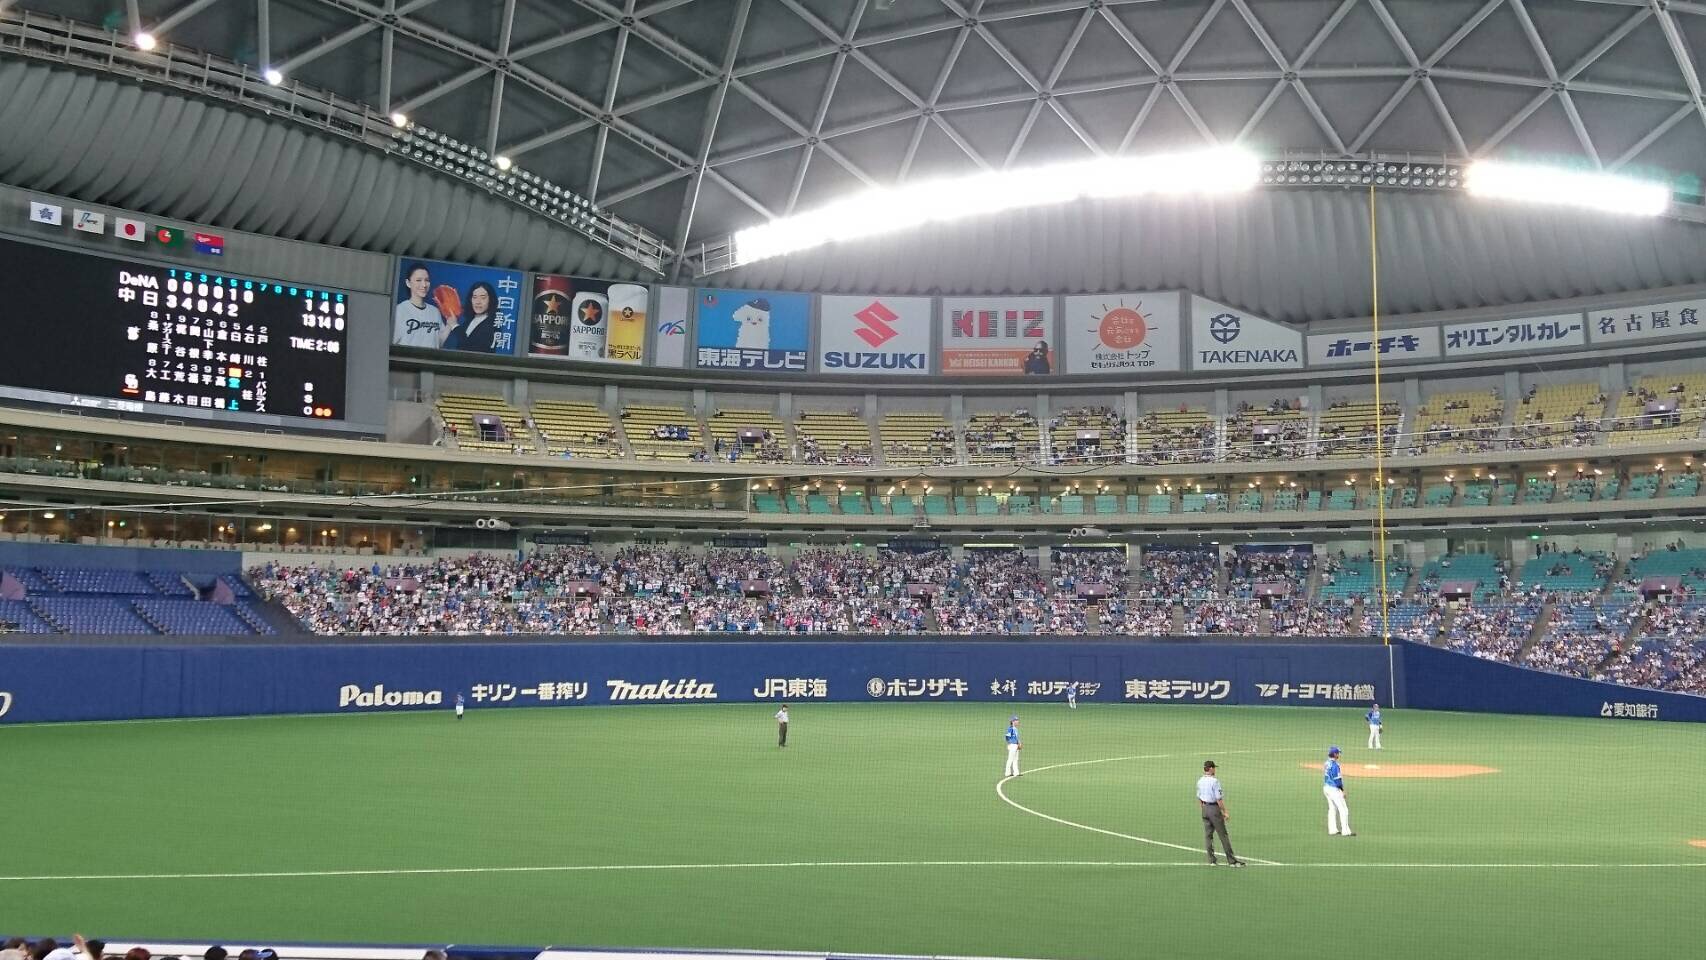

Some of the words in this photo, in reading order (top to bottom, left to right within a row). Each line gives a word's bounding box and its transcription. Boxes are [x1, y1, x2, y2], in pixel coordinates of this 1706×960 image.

[119, 271, 159, 290] DeNA
[167, 279, 178, 292] 0
[182, 281, 193, 294] 0
[197, 284, 208, 297] 0
[213, 286, 223, 299] 0
[228, 288, 237, 301] 1
[243, 290, 253, 303] 0
[305, 299, 313, 312] 1
[319, 301, 329, 314] 4
[335, 303, 344, 316] 0
[170, 269, 176, 278] 1
[184, 272, 192, 280] 2
[199, 274, 208, 283] 3
[214, 277, 222, 285] 4
[230, 279, 238, 287] 5
[244, 281, 252, 290] 6
[260, 284, 268, 292] 7
[274, 286, 282, 294] 8
[289, 288, 297, 296] 9
[336, 294, 343, 302] E
[118, 287, 159, 307] 中日
[166, 295, 177, 308] 3
[181, 297, 192, 310] 4
[197, 299, 208, 312] 0
[212, 302, 223, 315] 4
[227, 304, 238, 317] 2
[301, 313, 316, 328] 13
[317, 315, 331, 329] 14
[334, 317, 344, 331] 0
[490, 275, 518, 350] 中日新聞
[150, 311, 158, 319] 8
[165, 313, 170, 321] 1
[178, 315, 186, 323] 9
[206, 319, 213, 327] 3
[233, 323, 240, 331] 5
[951, 310, 1044, 338] KEIZ
[1598, 307, 1699, 335] 名古屋食
[290, 336, 315, 350] TIME
[1447, 321, 1581, 349] オリエンタルカレー
[608, 349, 641, 360] 黒ラベル
[1126, 349, 1151, 359] トップ
[1326, 334, 1419, 357] ホーチキ
[697, 347, 806, 369] 東海テレビ
[824, 351, 926, 369] SUZUKI
[1200, 349, 1298, 364] TAKENAKA
[149, 359, 157, 367] 8
[176, 362, 184, 370] 4
[190, 364, 197, 372] 3
[217, 367, 225, 375] 5
[304, 394, 313, 403] S
[339, 684, 442, 707] Paloma
[471, 681, 588, 702] キリン一番搾り
[753, 678, 828, 698] JR東海
[887, 678, 968, 697] ホシザキ
[1124, 679, 1232, 700] 東芝テック
[1281, 683, 1376, 701] トヨタ紡織
[1613, 702, 1658, 718] 愛知銀行
